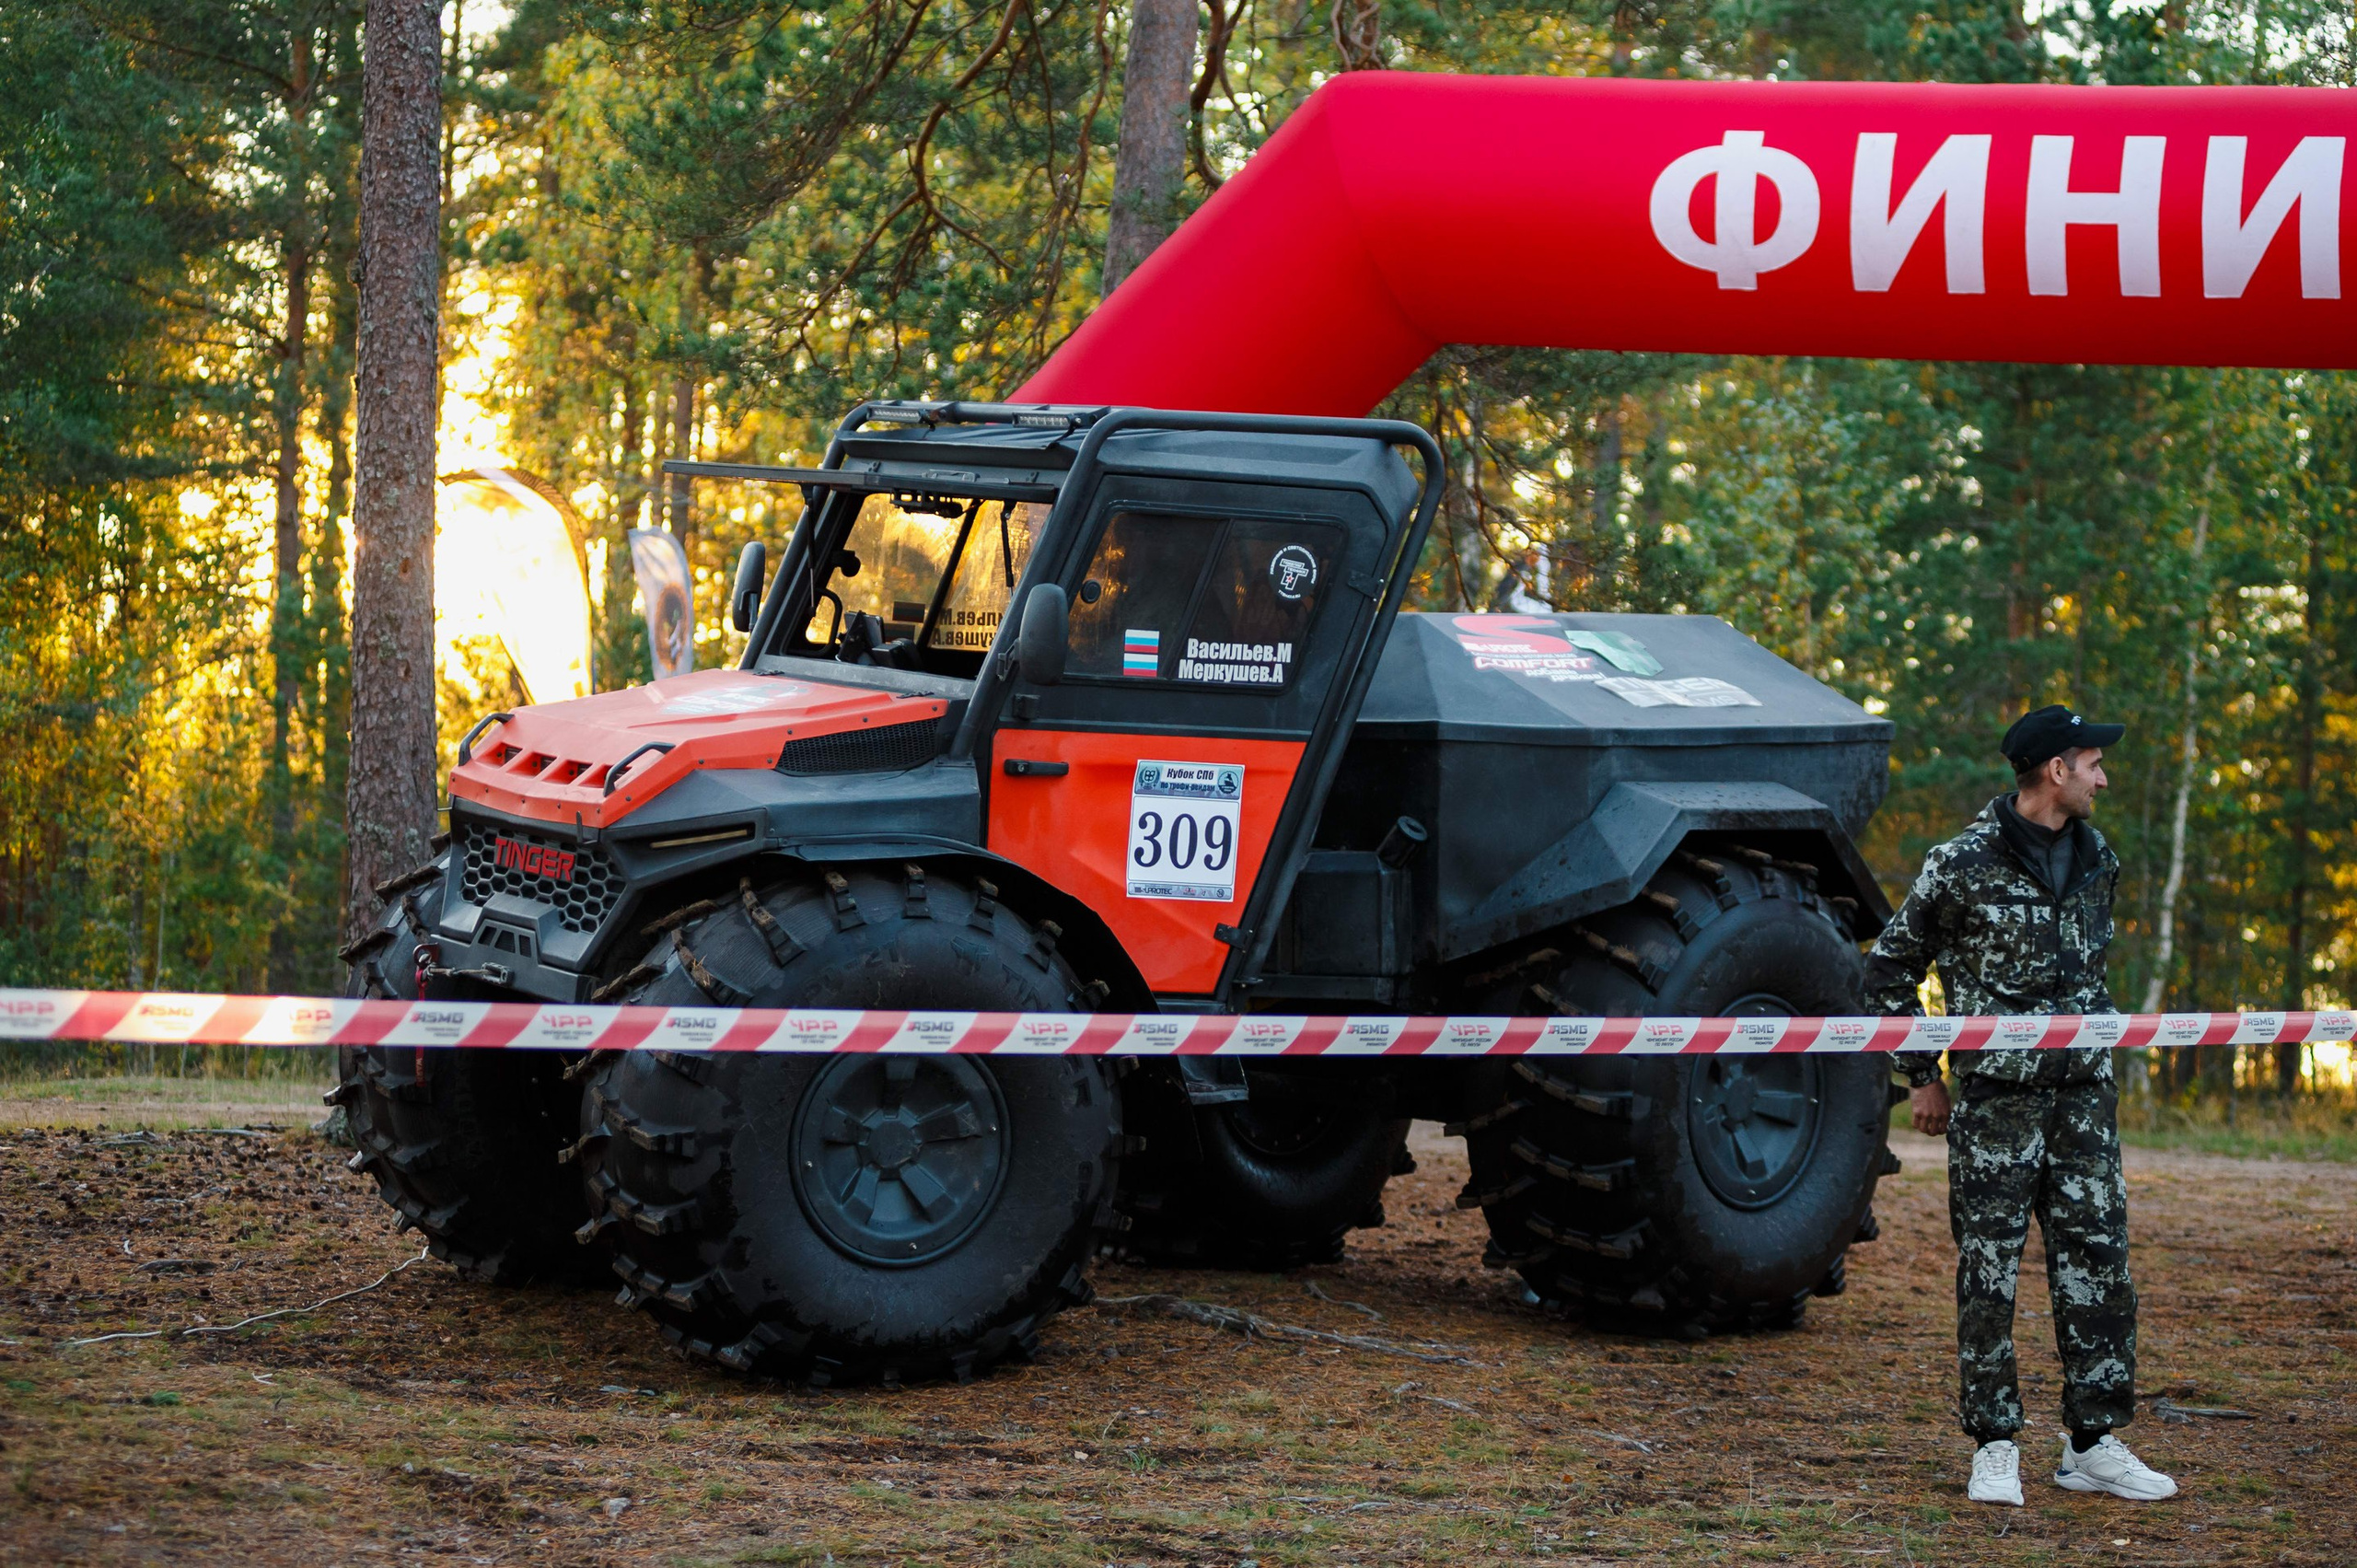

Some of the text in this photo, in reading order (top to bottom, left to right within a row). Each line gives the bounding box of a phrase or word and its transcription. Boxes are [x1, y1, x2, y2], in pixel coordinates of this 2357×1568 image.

[1649, 130, 2346, 298] ФИНИ
[1187, 638, 1293, 663] Васильев.М
[1474, 656, 1592, 670] COMFORT
[1178, 659, 1283, 682] Меркушев.А
[1167, 768, 1214, 781] Кубок СПб
[1160, 781, 1168, 789] по
[1169, 782, 1215, 793] трофи-рейдам
[1133, 811, 1232, 871] 309
[494, 837, 575, 881] TINGER
[541, 1015, 593, 1028] ЧРР
[668, 1017, 716, 1028] ASMG
[789, 1019, 838, 1032] ЧРР
[908, 1021, 954, 1032] ASMG
[2001, 1021, 2037, 1032] ЧРР
[2085, 1020, 2118, 1030] ASMG
[2165, 1019, 2198, 1029] ЧРР
[2244, 1017, 2275, 1027] ASMG
[2319, 1016, 2351, 1026] ЧРР
[1023, 1022, 1068, 1035] ЧРР
[1134, 1023, 1178, 1034] ASMG
[1243, 1024, 1285, 1036] ЧРР
[1348, 1024, 1389, 1035] ASMG
[1449, 1024, 1492, 1036] ЧРР
[1549, 1024, 1588, 1035] ASMG
[1644, 1024, 1683, 1036] ЧРР
[1737, 1024, 1775, 1034] ASMG
[1828, 1023, 1864, 1035] ЧРР
[1916, 1023, 1952, 1032] ASMG
